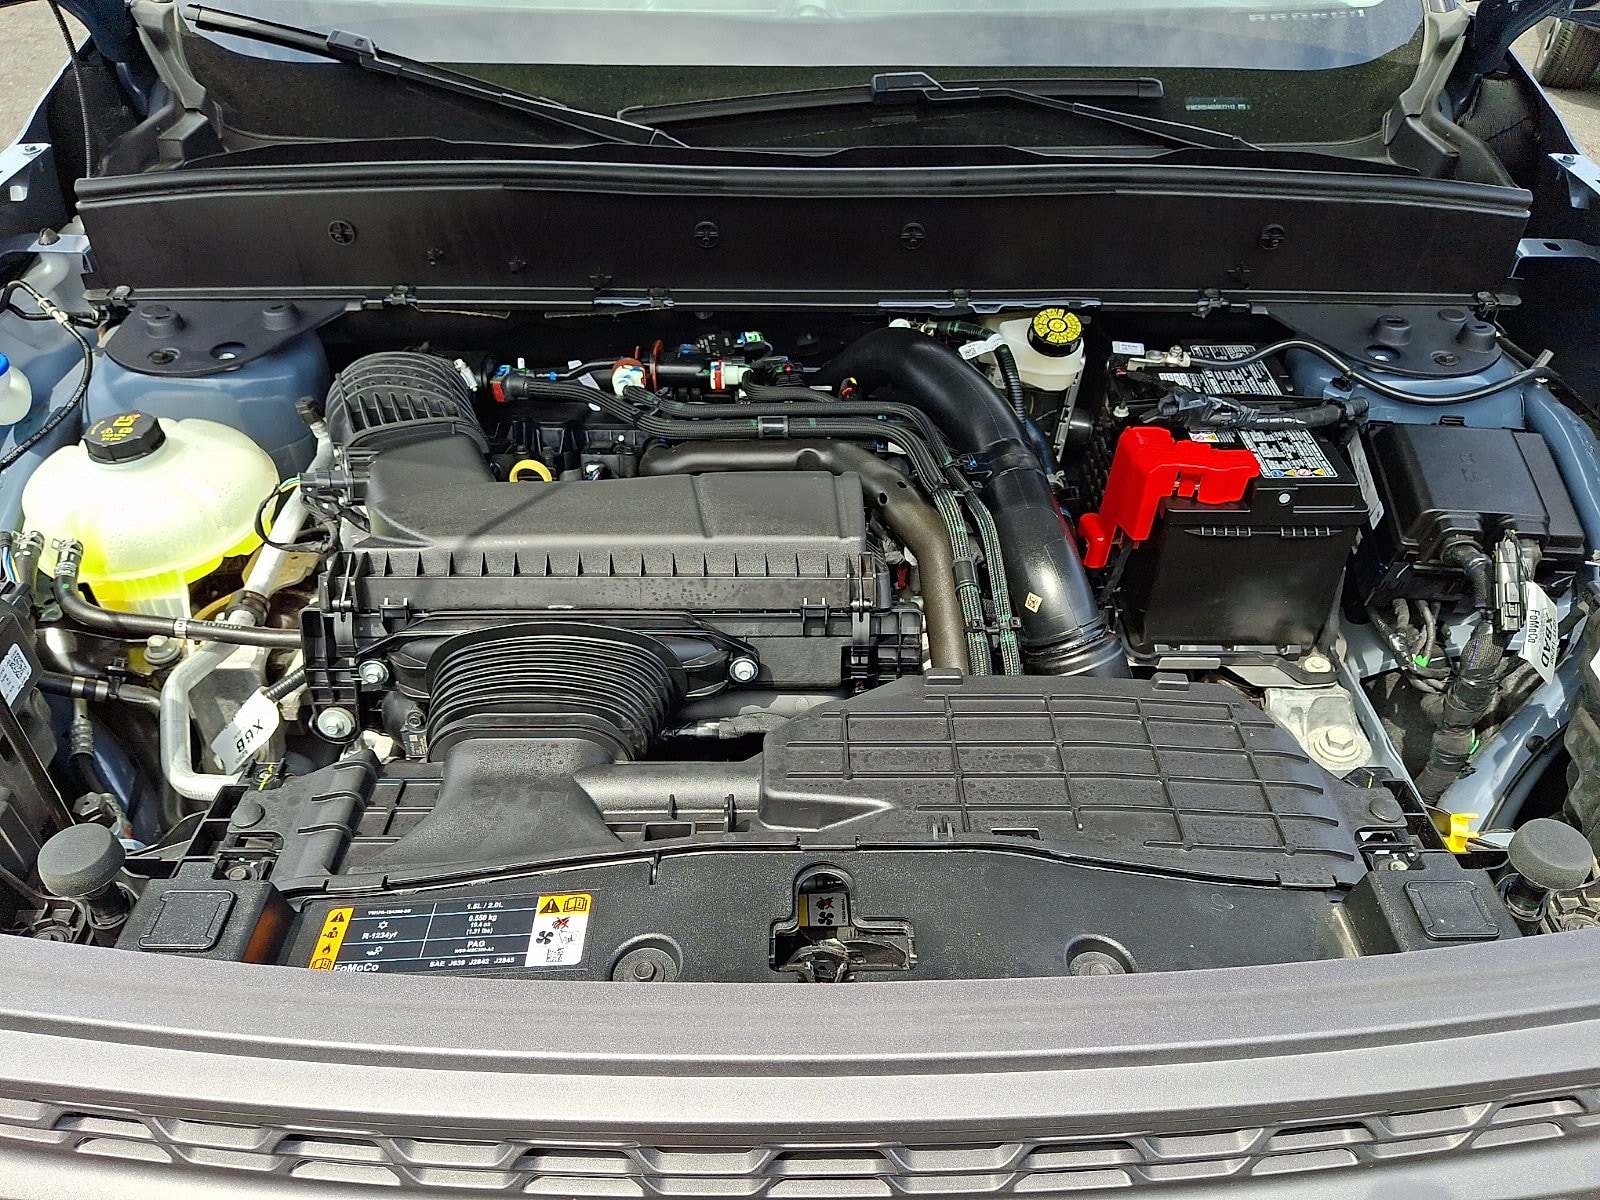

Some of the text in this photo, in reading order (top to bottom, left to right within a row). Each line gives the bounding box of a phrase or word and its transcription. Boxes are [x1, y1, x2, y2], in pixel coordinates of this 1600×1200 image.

[1528, 610, 1540, 643] FoMoCo
[1541, 612, 1552, 668] XBAD
[488, 914, 497, 922] kg
[361, 931, 398, 940] R-1234yf
[334, 963, 379, 972] FoMoCo
[429, 960, 445, 968] SAE
